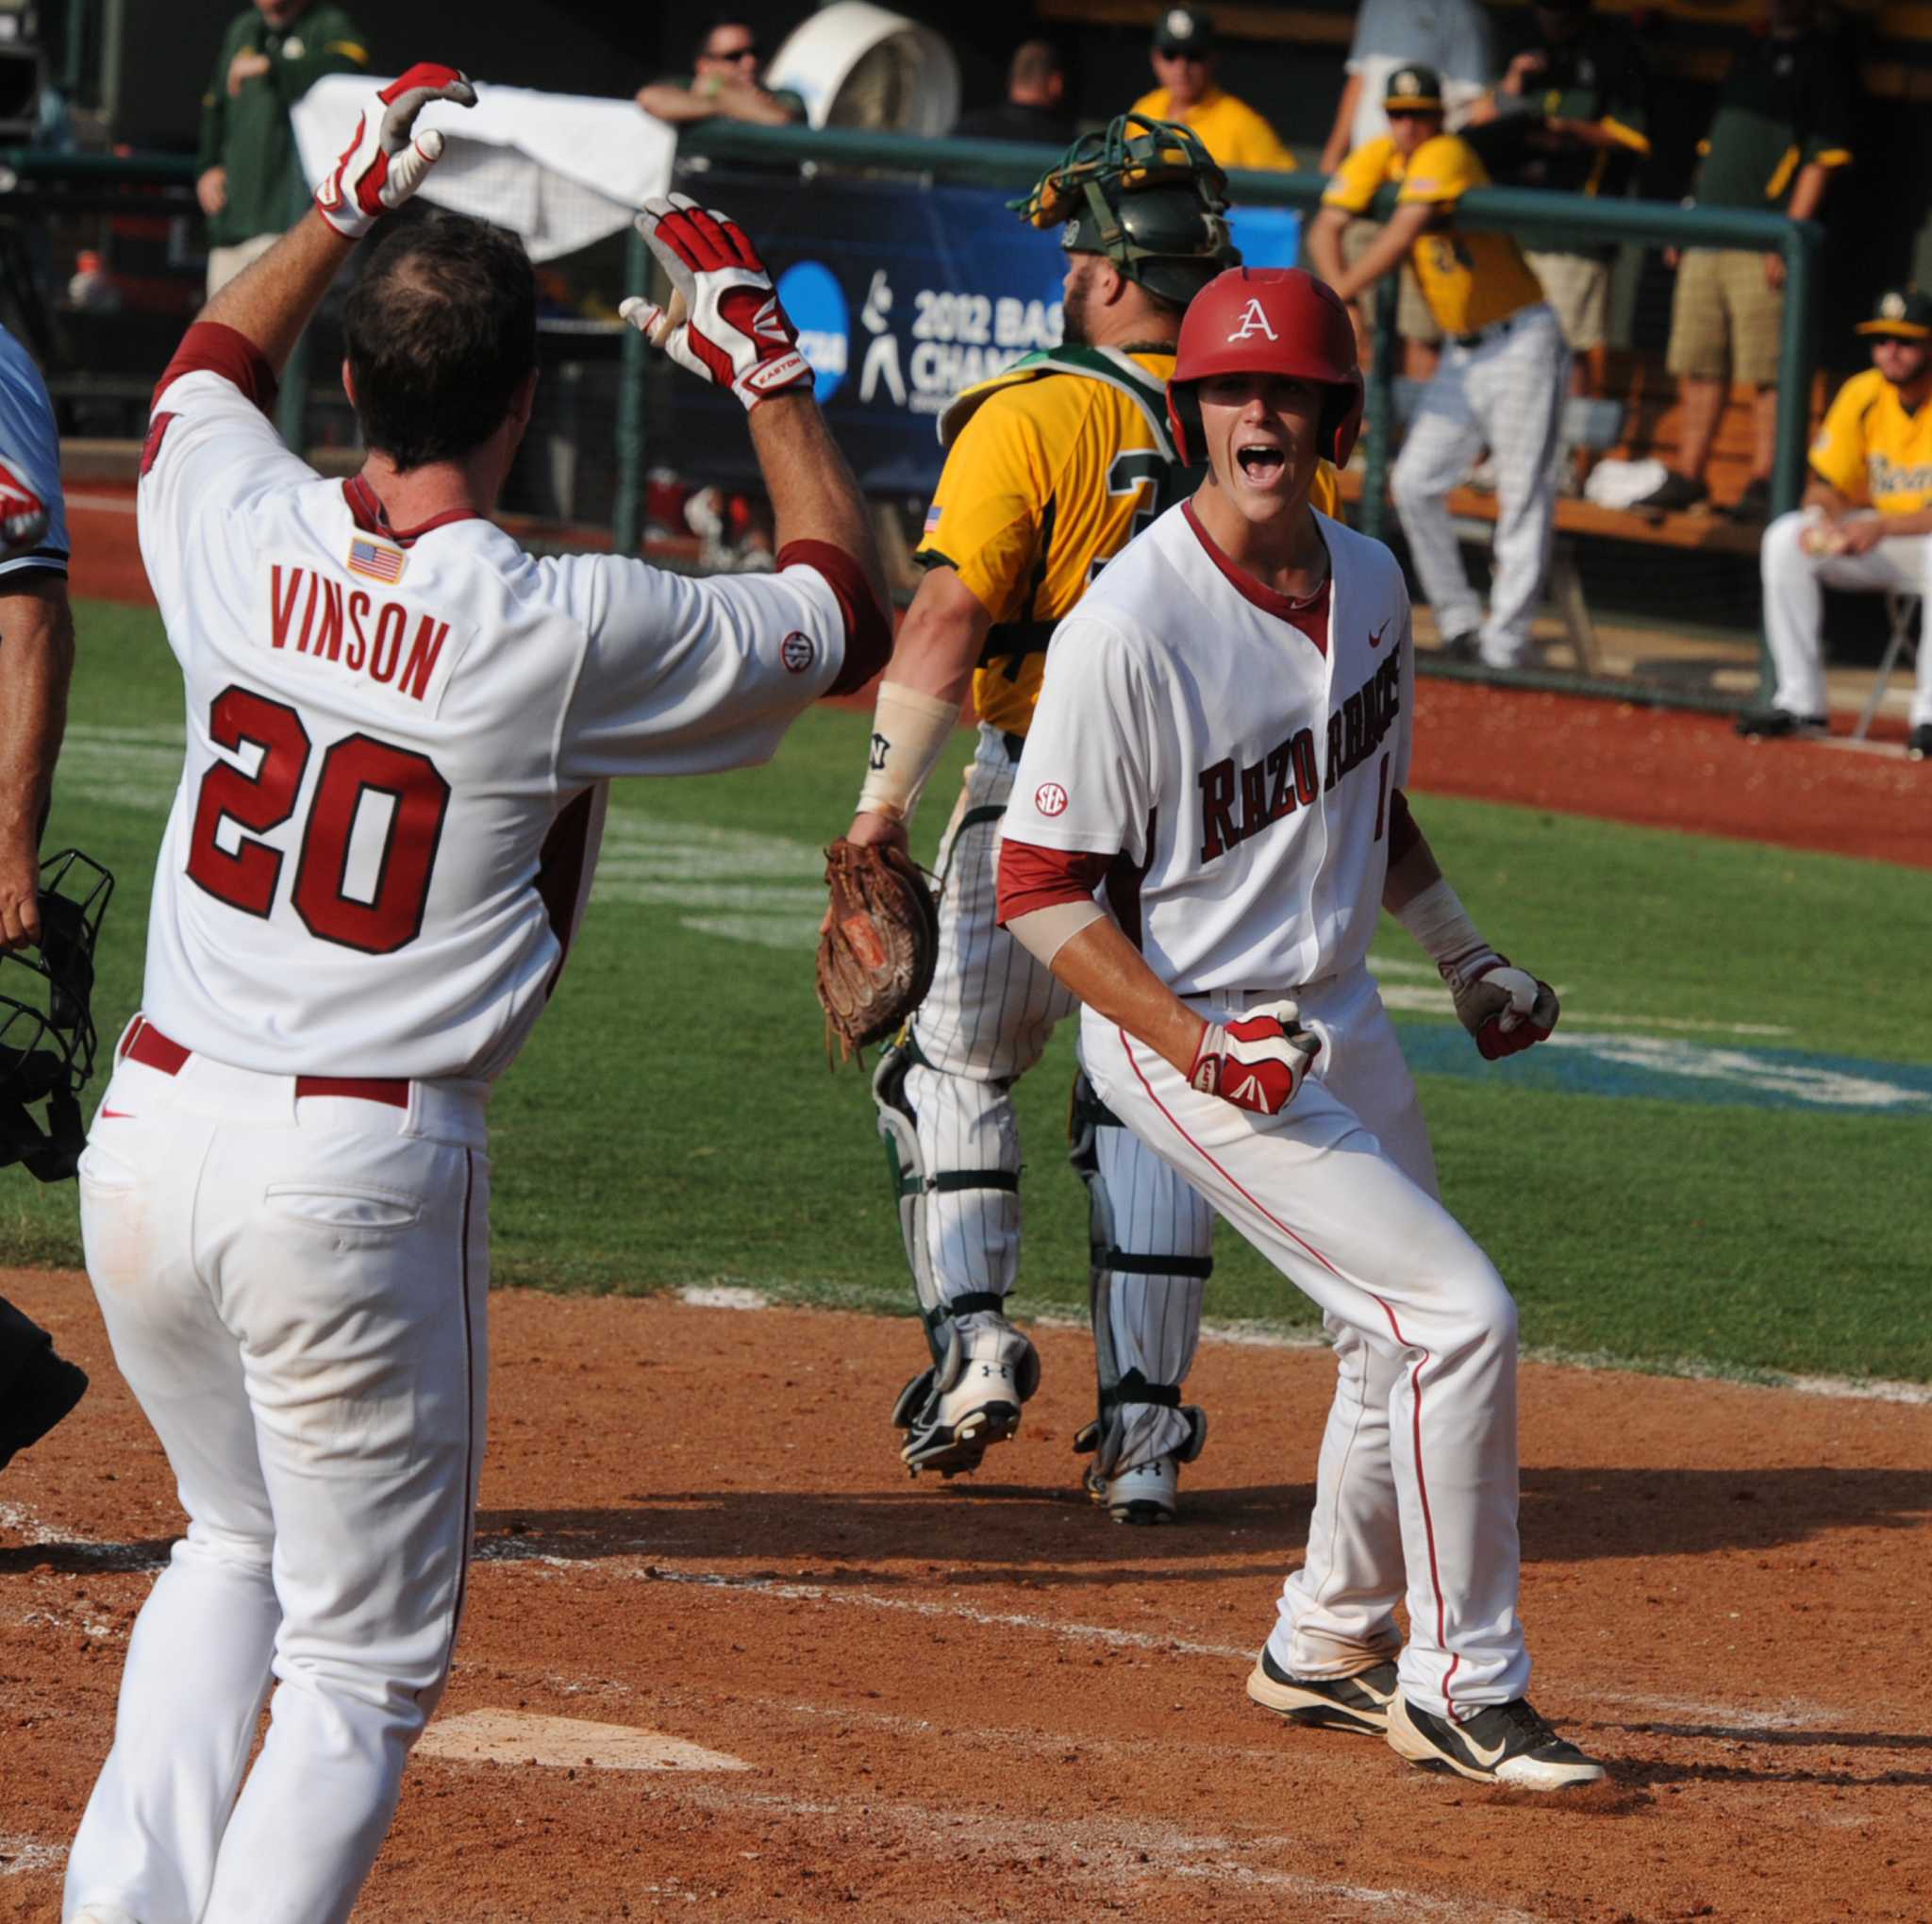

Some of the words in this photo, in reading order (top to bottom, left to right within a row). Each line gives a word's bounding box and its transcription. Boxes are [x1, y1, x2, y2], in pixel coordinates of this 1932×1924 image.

[911, 289, 991, 345] 2012
[1227, 298, 1278, 343] A
[758, 357, 802, 384] EASTON
[271, 564, 450, 701] VINSON
[185, 683, 452, 956] 20
[1037, 784, 1068, 814] SEC
